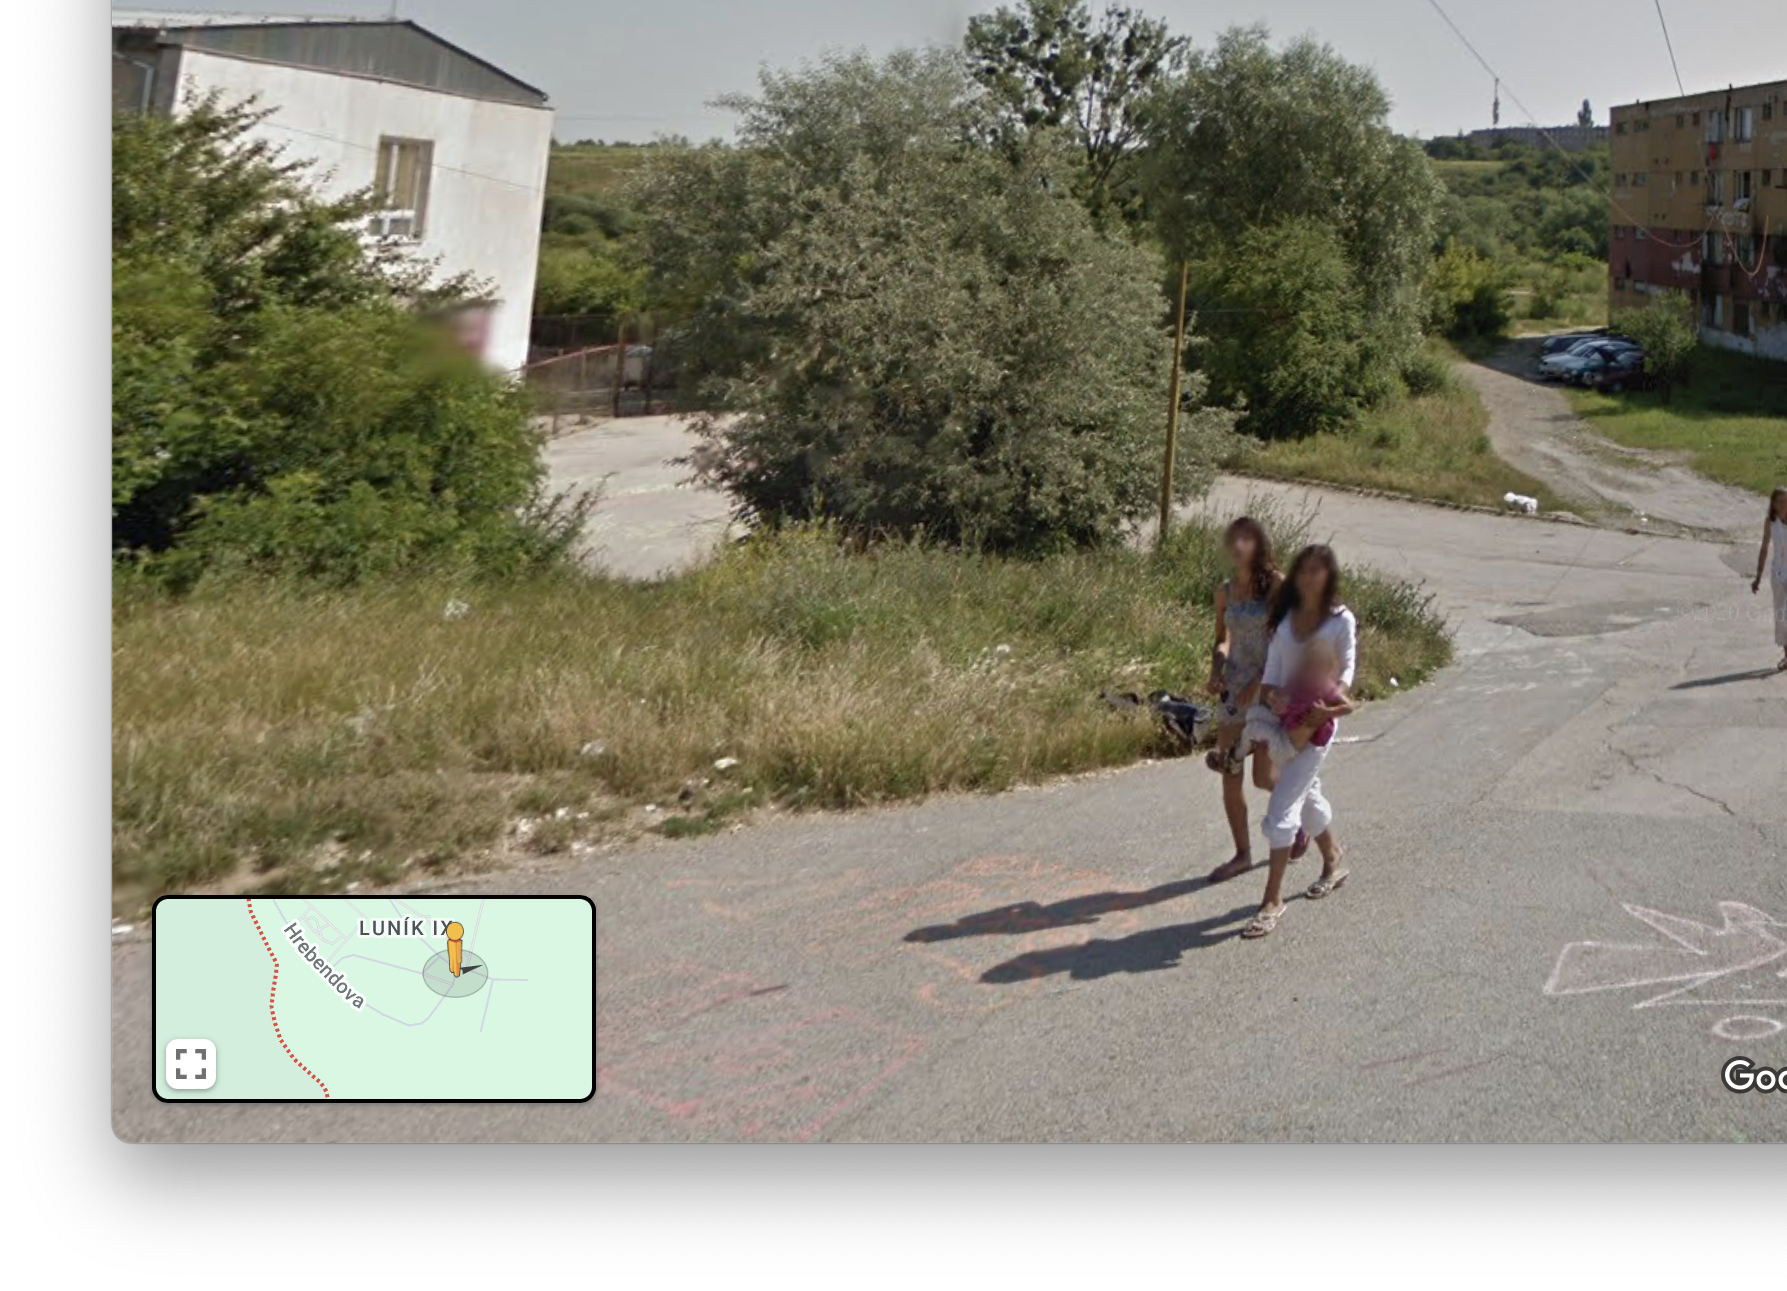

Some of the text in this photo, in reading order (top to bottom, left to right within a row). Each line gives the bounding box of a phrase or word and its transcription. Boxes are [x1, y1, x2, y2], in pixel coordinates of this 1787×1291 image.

[359, 916, 453, 936] LUNÍK IX
[283, 921, 364, 1009] Hrebendova
